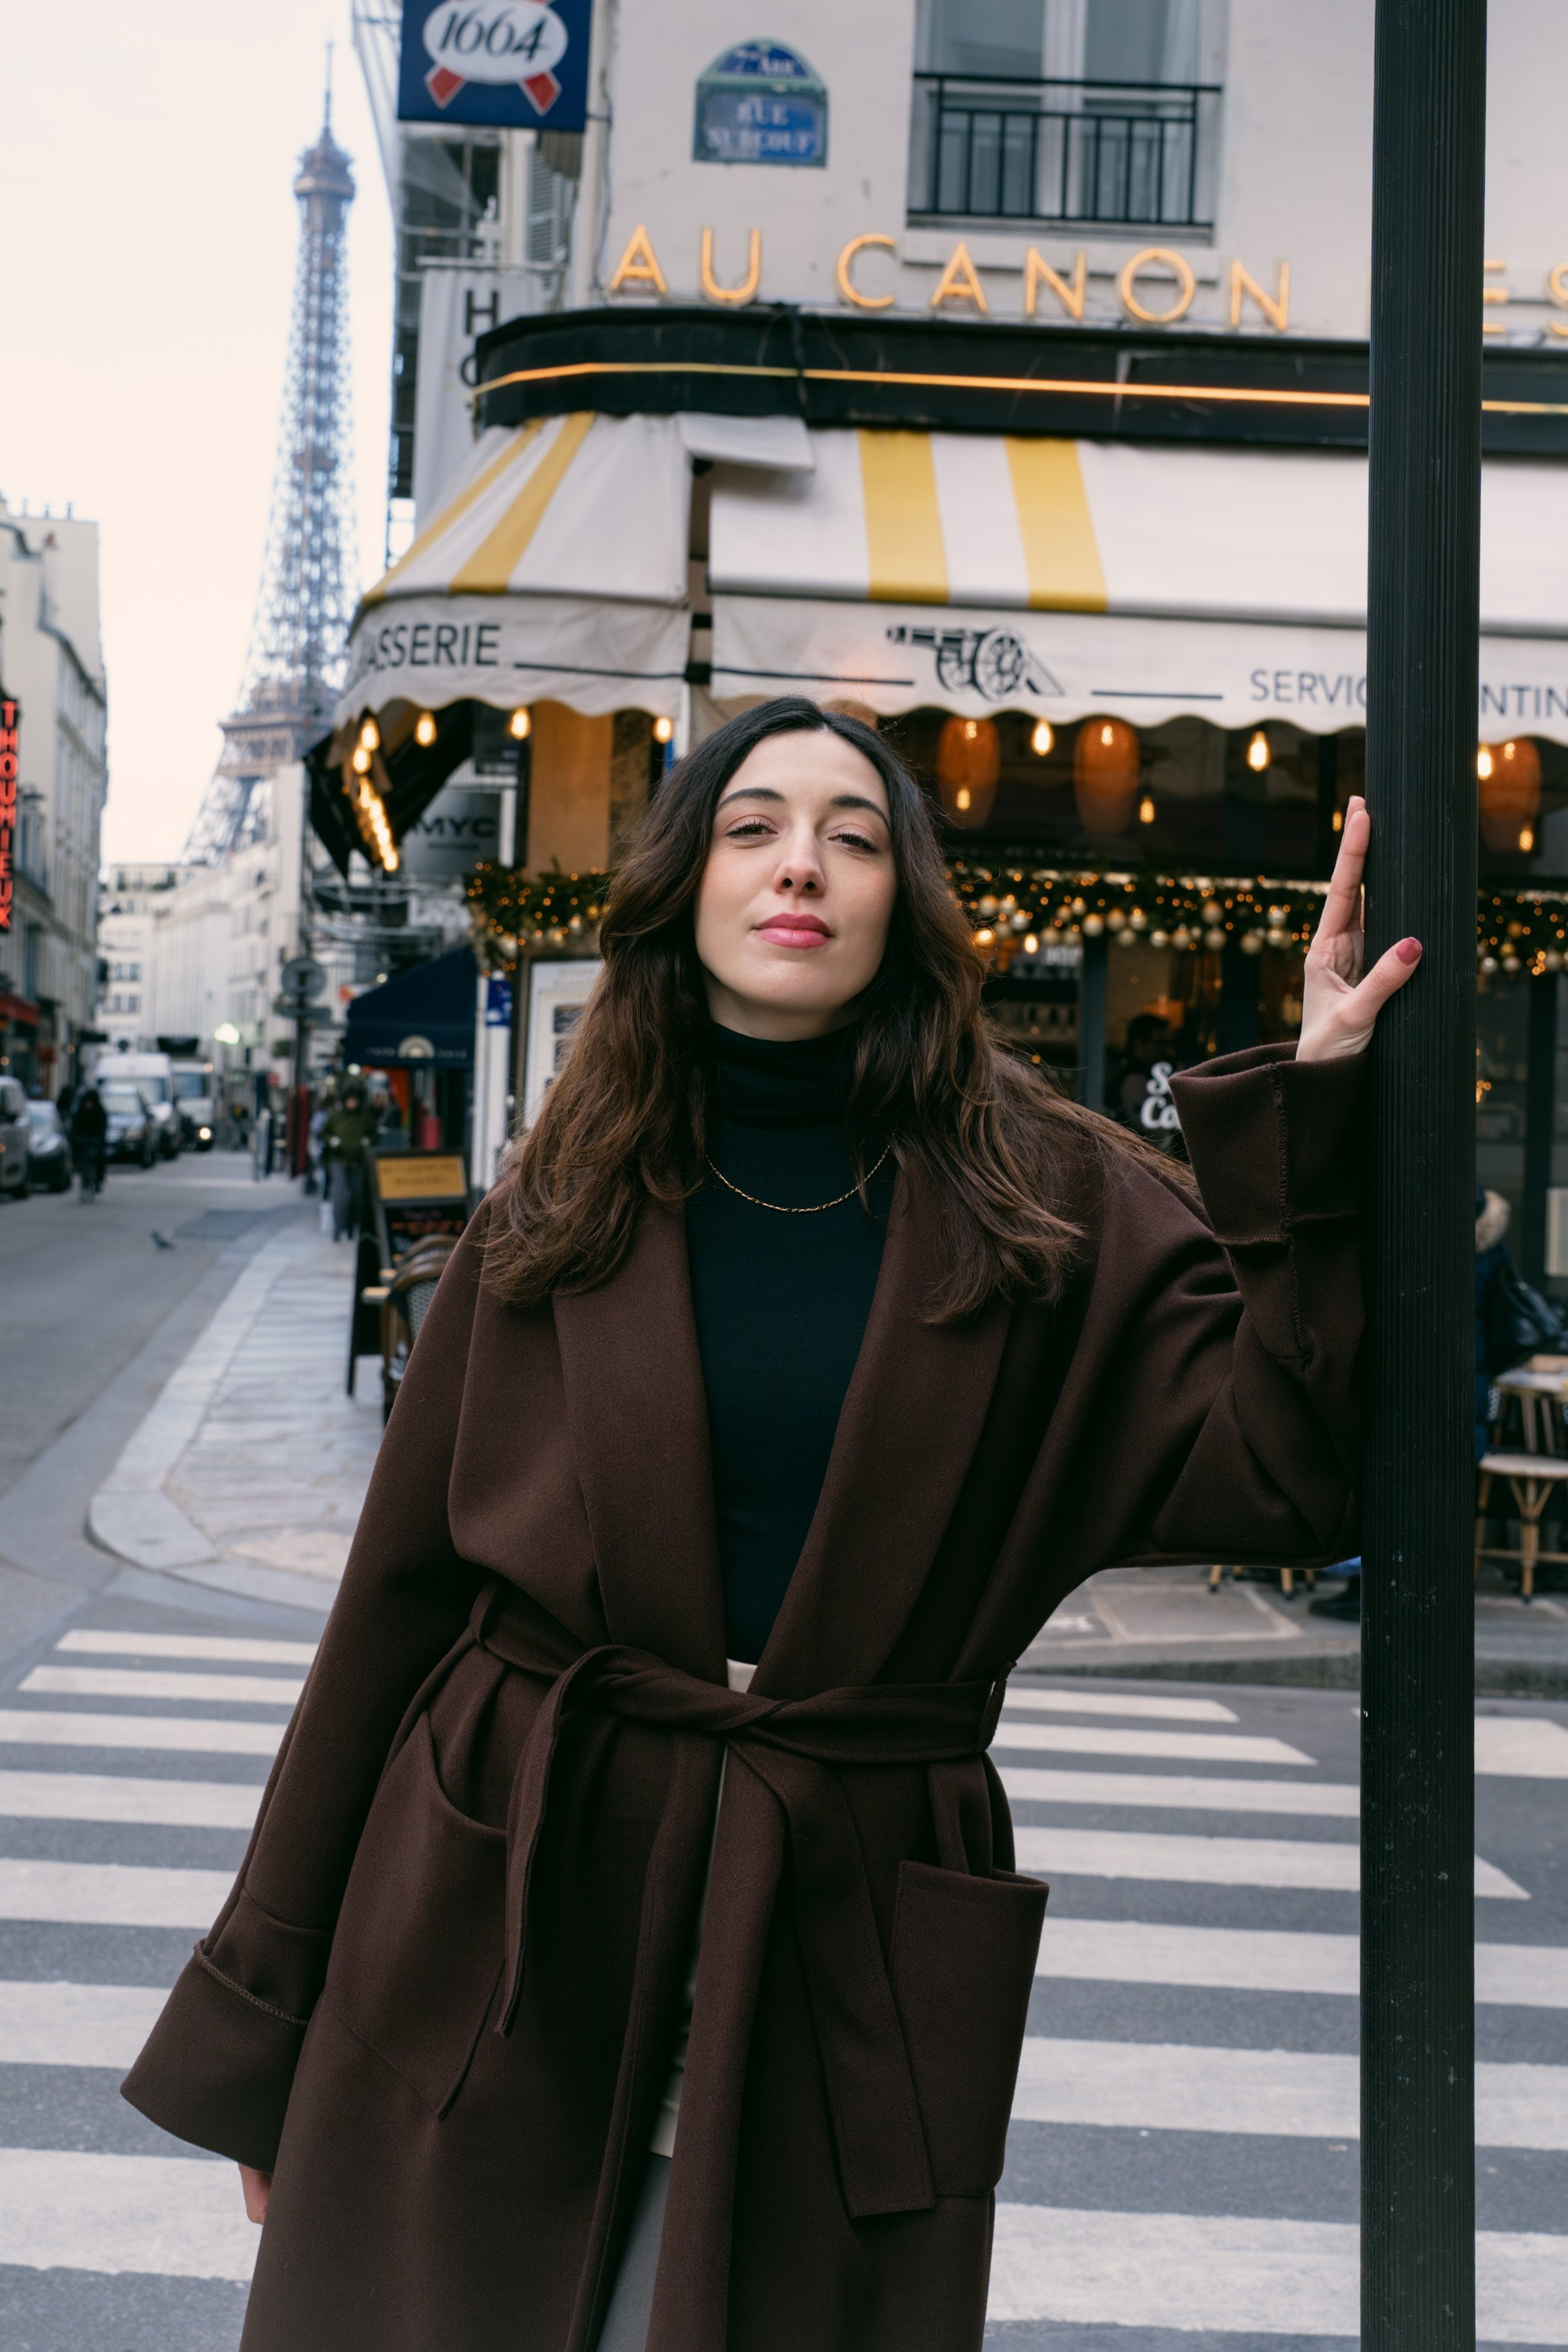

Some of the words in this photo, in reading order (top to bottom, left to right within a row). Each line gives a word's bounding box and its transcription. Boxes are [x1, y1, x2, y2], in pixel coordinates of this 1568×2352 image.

[438, 5, 553, 63] 1664
[608, 222, 760, 303] AU
[836, 233, 1290, 332] CANON
